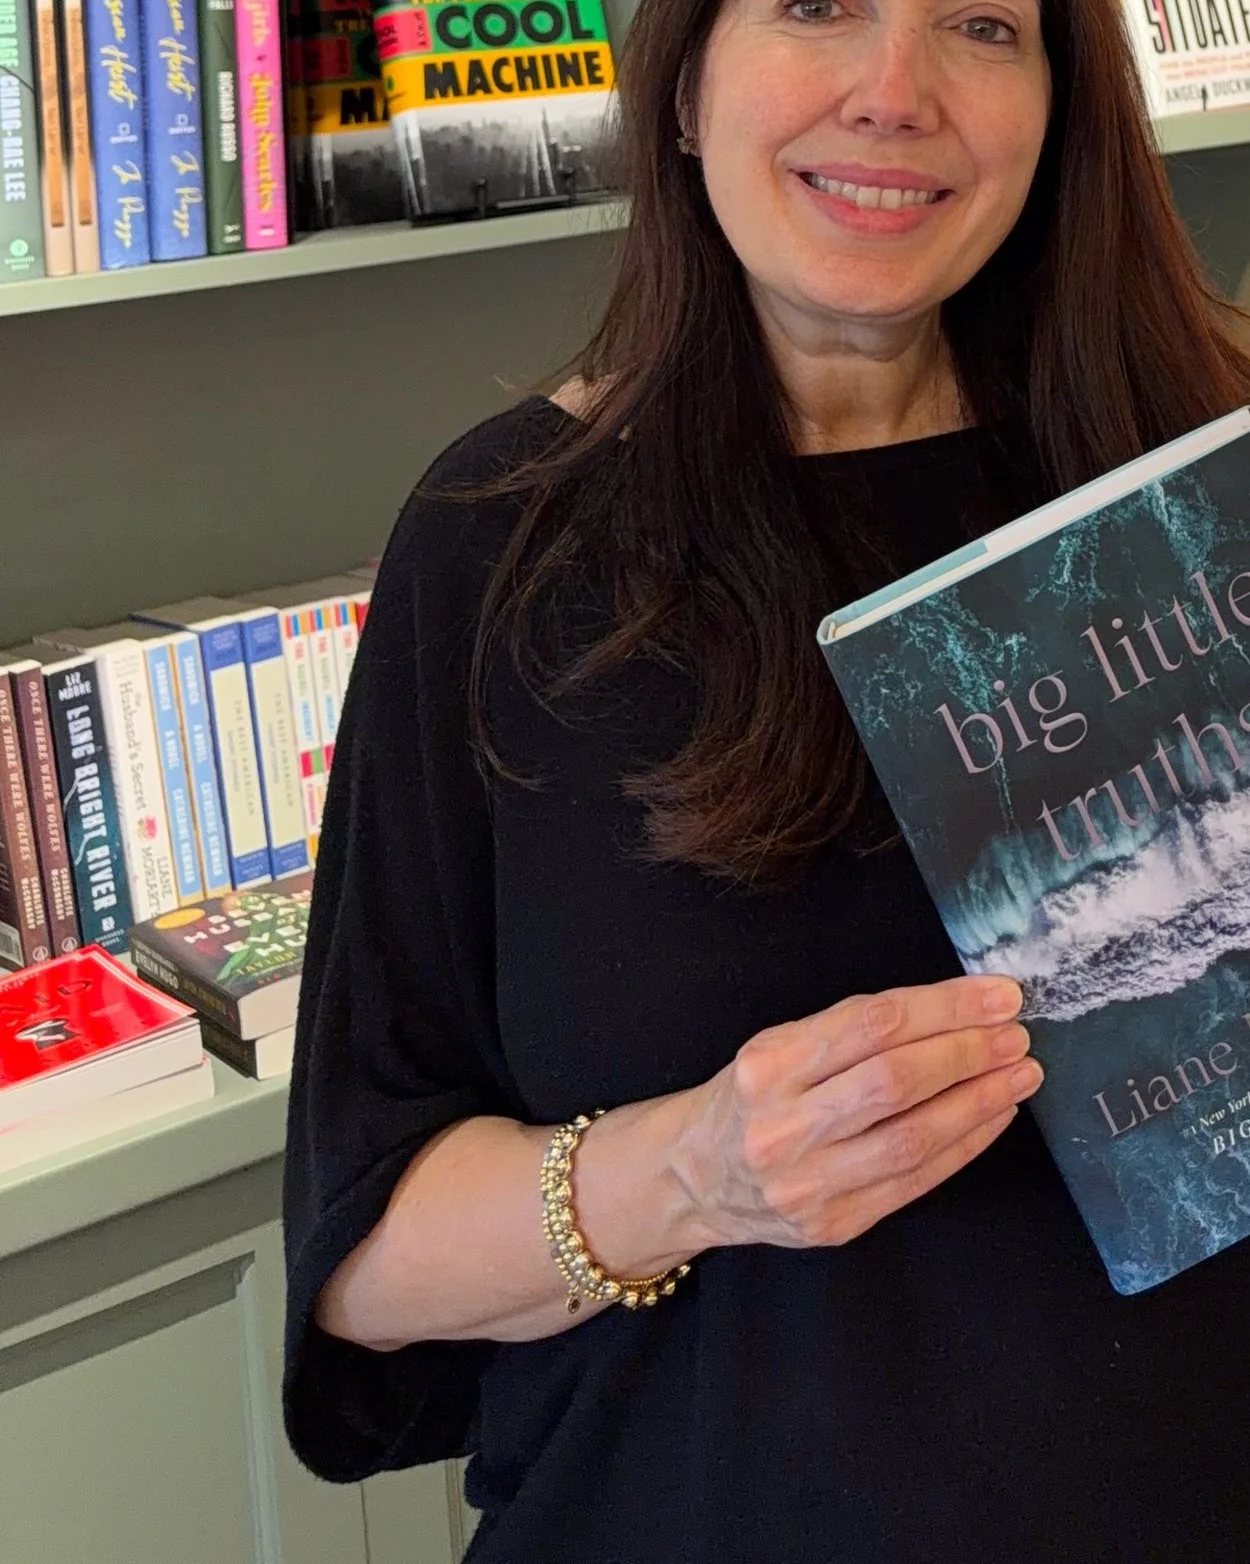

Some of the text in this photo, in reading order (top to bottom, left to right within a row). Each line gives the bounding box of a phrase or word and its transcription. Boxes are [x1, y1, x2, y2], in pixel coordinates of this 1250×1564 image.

[435, 1, 595, 49] COOL
[0, 38, 18, 67] AGE
[158, 37, 196, 101] Heist
[424, 51, 605, 101] MACHINE
[100, 45, 138, 110] Heist
[1, 74, 26, 201] CHANG-RAE LEE
[218, 71, 237, 163] RICHARD RUSSO
[248, 72, 278, 213] John Searles
[58, 681, 92, 701] MOORE
[65, 672, 81, 686] LIZ
[2, 726, 17, 768] THERE
[120, 682, 147, 810] Husband's Secret
[934, 670, 1087, 775] big
[8, 770, 23, 809] WERE
[29, 681, 61, 852] ONCE THERE WERE WOLVES
[66, 706, 117, 912] LONG BRIGHT RIVER
[14, 811, 30, 860] WOLVES
[30, 877, 45, 925] CHARLOTTE
[60, 868, 74, 917] CHARLOTTE
[157, 857, 173, 898] LIANE
[1092, 1041, 1240, 1137] Liane
[1199, 1108, 1227, 1130] New
